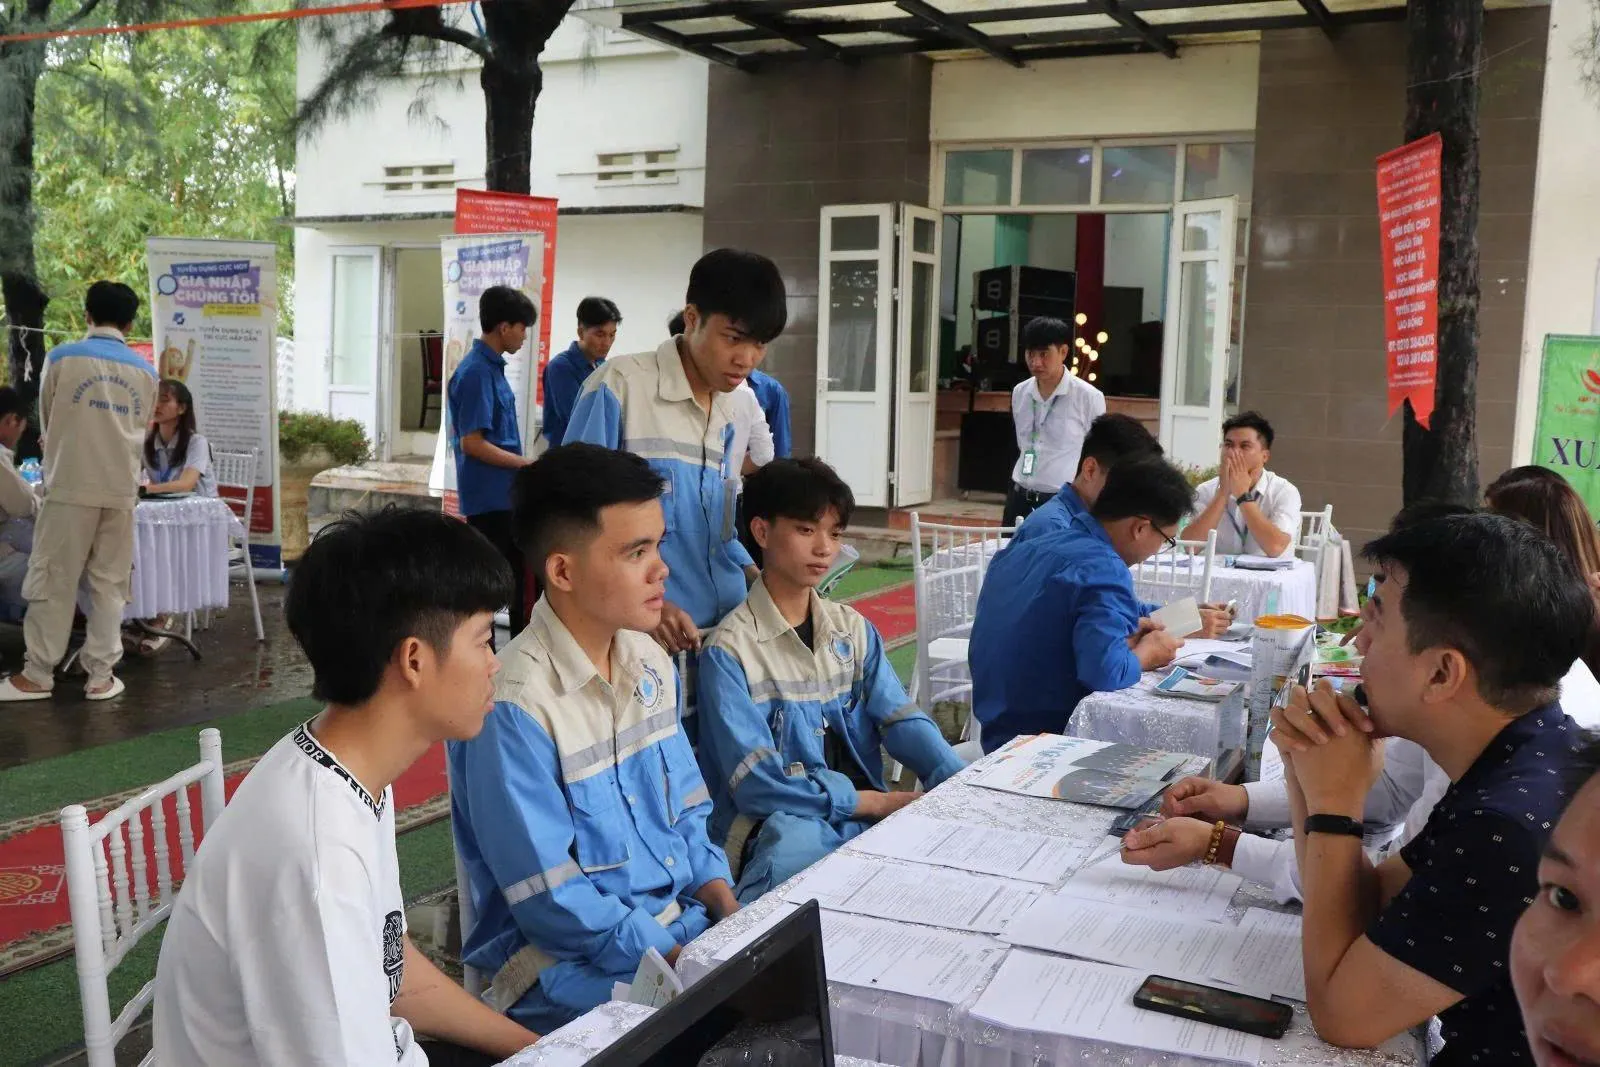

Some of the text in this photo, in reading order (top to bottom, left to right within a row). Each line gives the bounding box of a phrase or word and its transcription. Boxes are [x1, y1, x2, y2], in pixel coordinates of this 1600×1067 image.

[1416, 216, 1430, 230] CHO
[177, 262, 197, 273] TUYỂN
[199, 264, 218, 273] DỤNG
[218, 264, 232, 272] CỰC
[178, 274, 205, 288] GIA
[174, 288, 228, 304] CHÚNG
[1549, 436, 1600, 470] XU
[295, 733, 324, 760] DIOR
